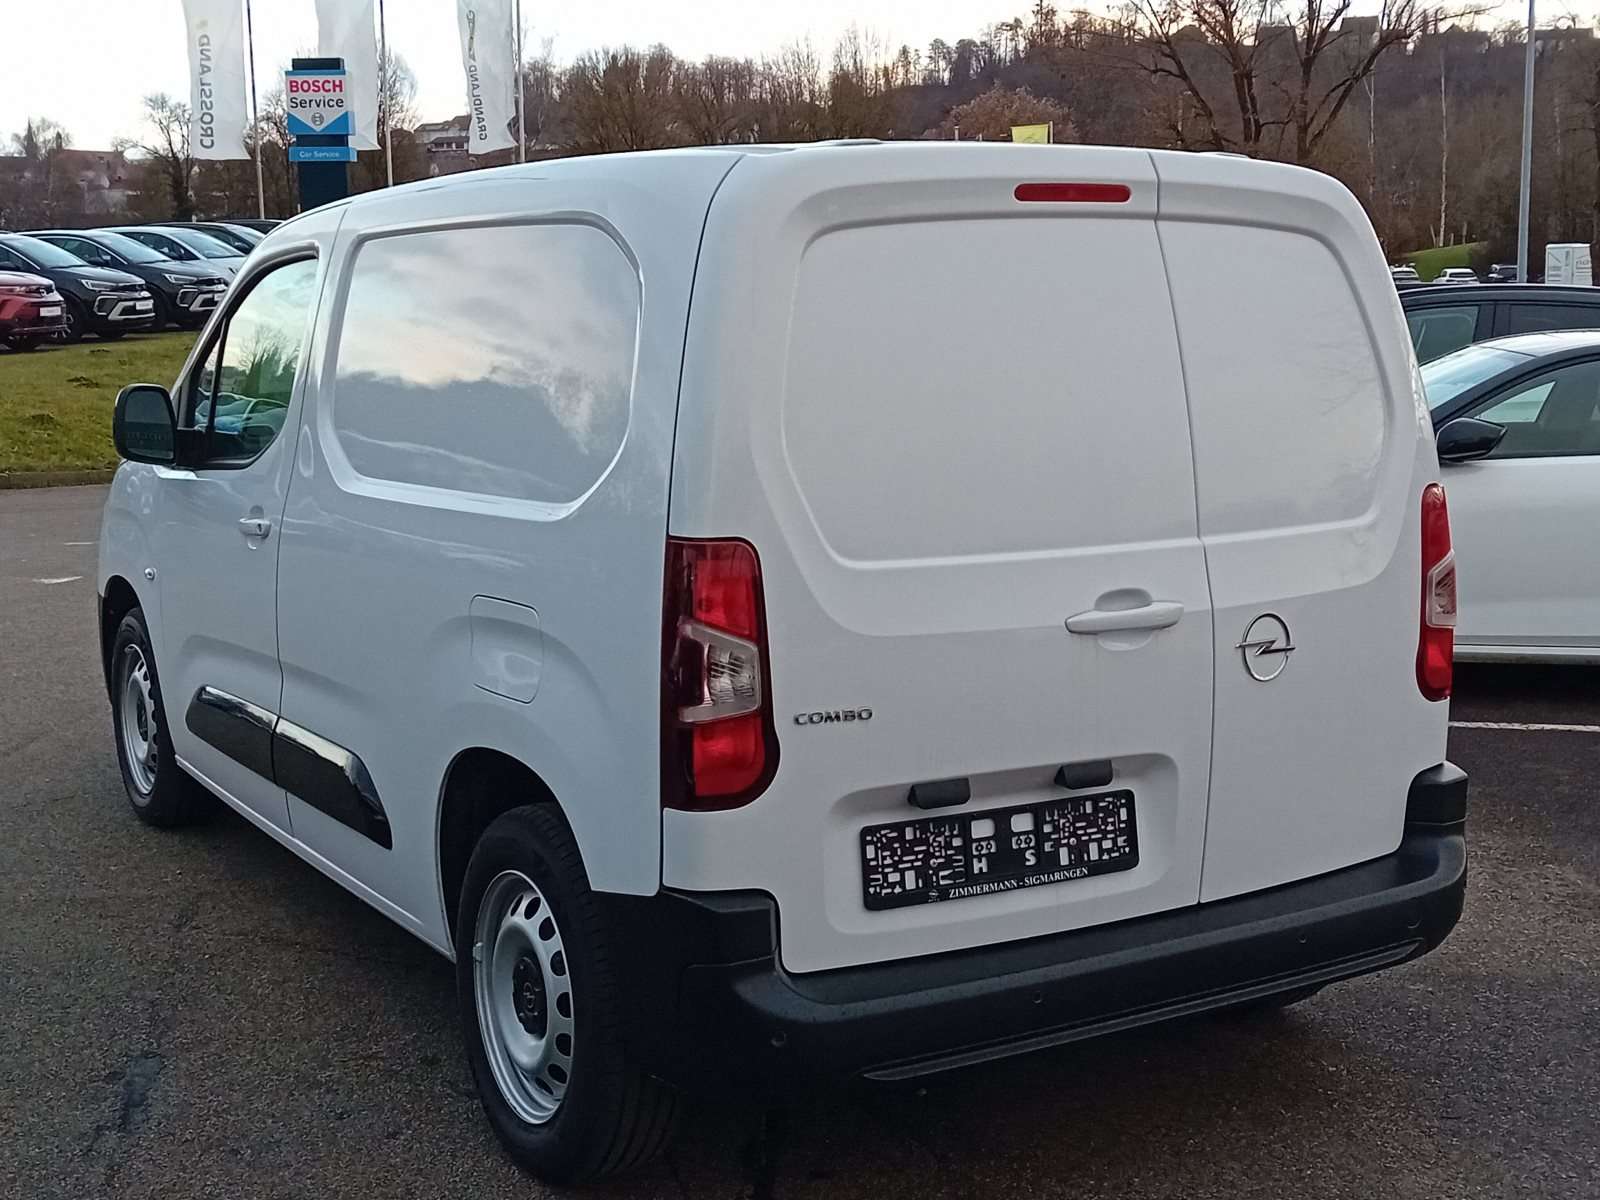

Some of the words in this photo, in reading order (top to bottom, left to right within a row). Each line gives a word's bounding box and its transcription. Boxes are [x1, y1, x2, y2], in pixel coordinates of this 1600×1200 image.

[289, 79, 343, 93] BOSCH
[290, 95, 344, 109] Service
[299, 150, 313, 158] Car
[314, 150, 340, 158] Service
[794, 708, 873, 726] COMBO
[949, 878, 1018, 898] ZIMMERMANN
[1024, 867, 1089, 887] SIGMARINGEN
